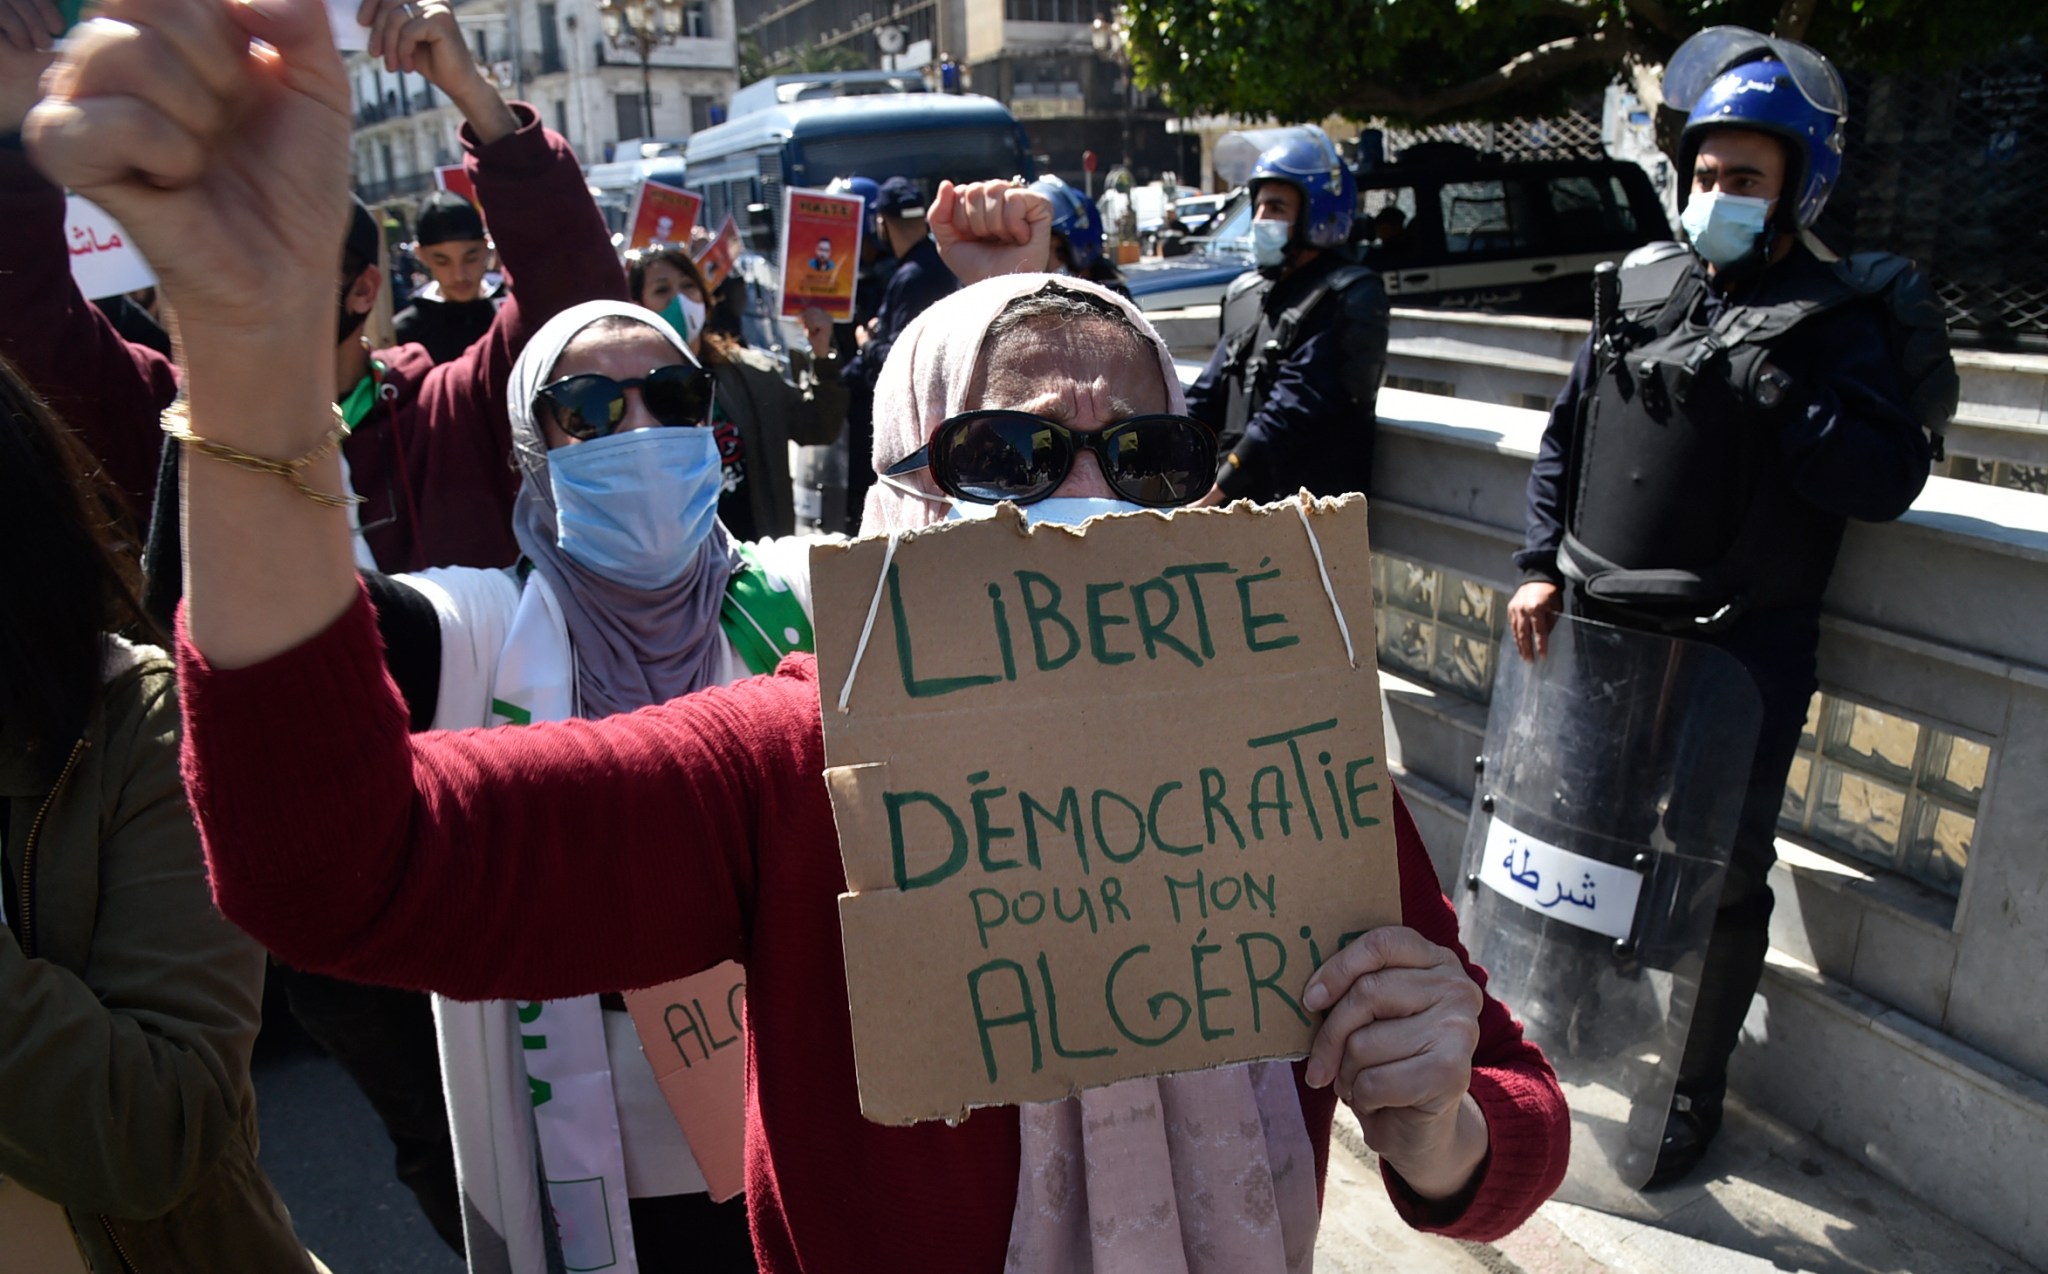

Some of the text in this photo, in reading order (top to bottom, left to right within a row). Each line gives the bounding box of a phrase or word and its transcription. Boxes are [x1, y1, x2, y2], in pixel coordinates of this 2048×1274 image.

[969, 871, 1278, 950] POUR MON
[1502, 837, 1597, 911] شرطة
